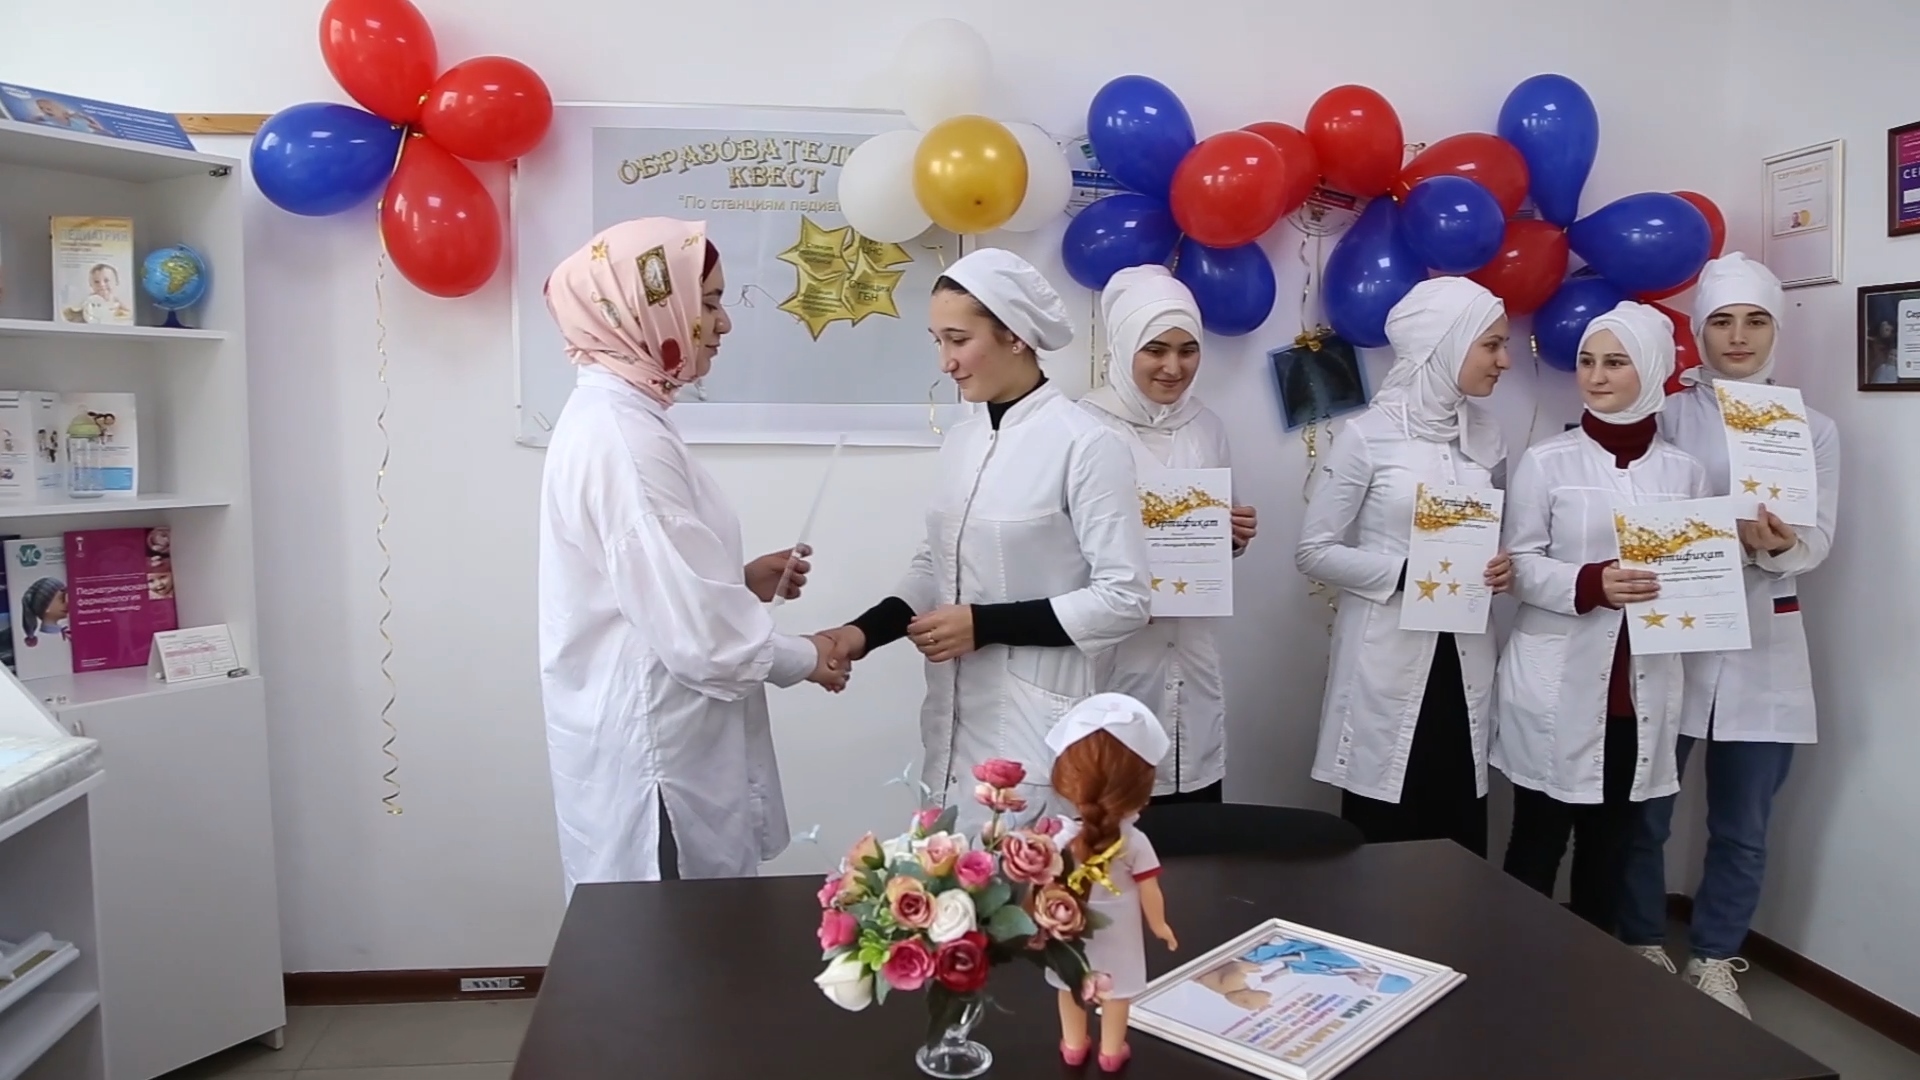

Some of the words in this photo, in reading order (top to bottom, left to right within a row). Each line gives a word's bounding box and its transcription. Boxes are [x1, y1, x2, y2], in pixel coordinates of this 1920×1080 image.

[728, 164, 826, 195] КВЕСТ
[1902, 166, 1920, 179] СЕ
[711, 198, 785, 212] станциям
[1149, 517, 1218, 530] Сертификат
[1644, 548, 1725, 566] Сертификат
